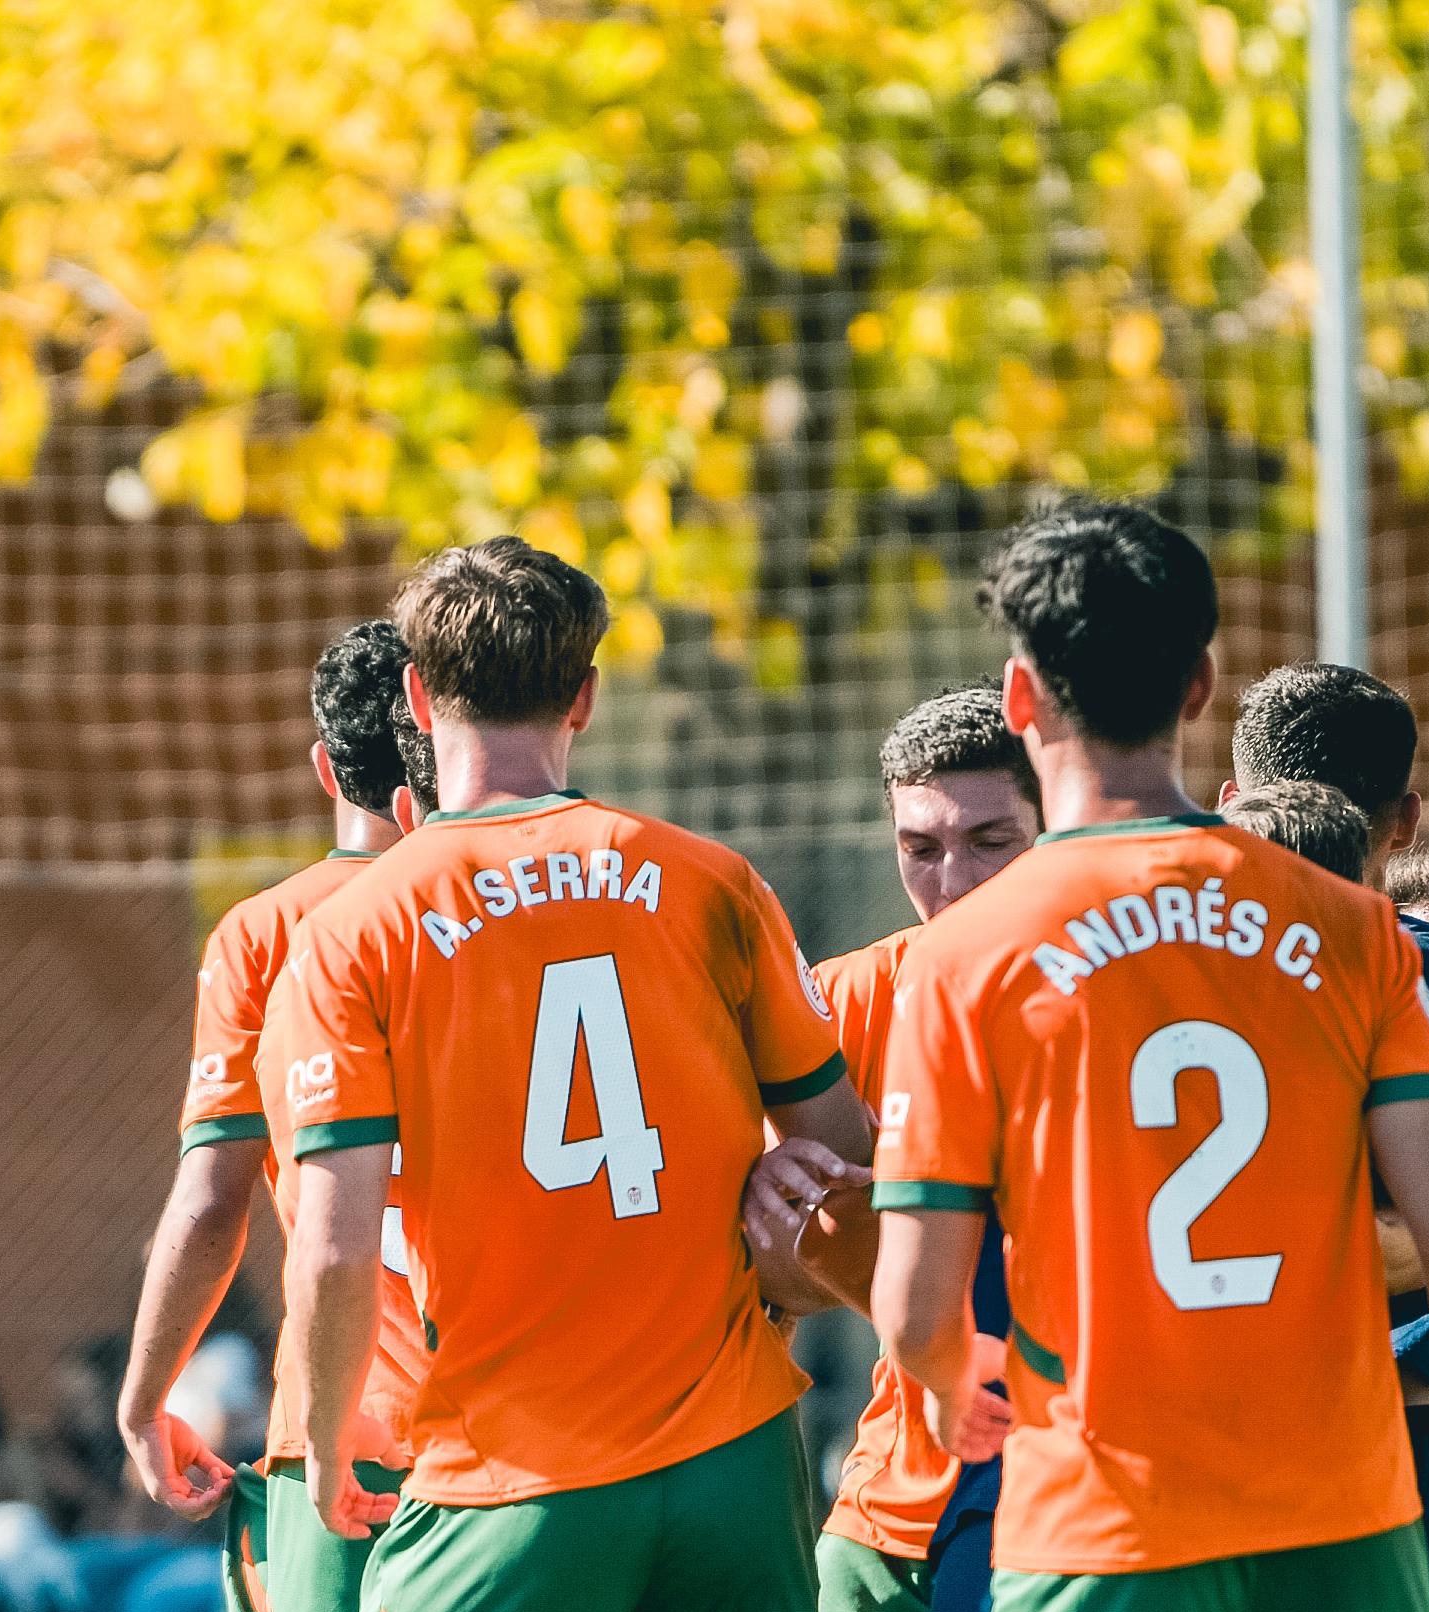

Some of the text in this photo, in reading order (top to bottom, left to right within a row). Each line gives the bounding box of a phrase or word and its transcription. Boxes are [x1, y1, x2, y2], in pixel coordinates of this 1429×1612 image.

[421, 848, 662, 960] A. SERRA
[1031, 877, 1323, 996] ANDRÉS C.
[522, 953, 665, 1221] 4
[1129, 1019, 1284, 1312] 2
